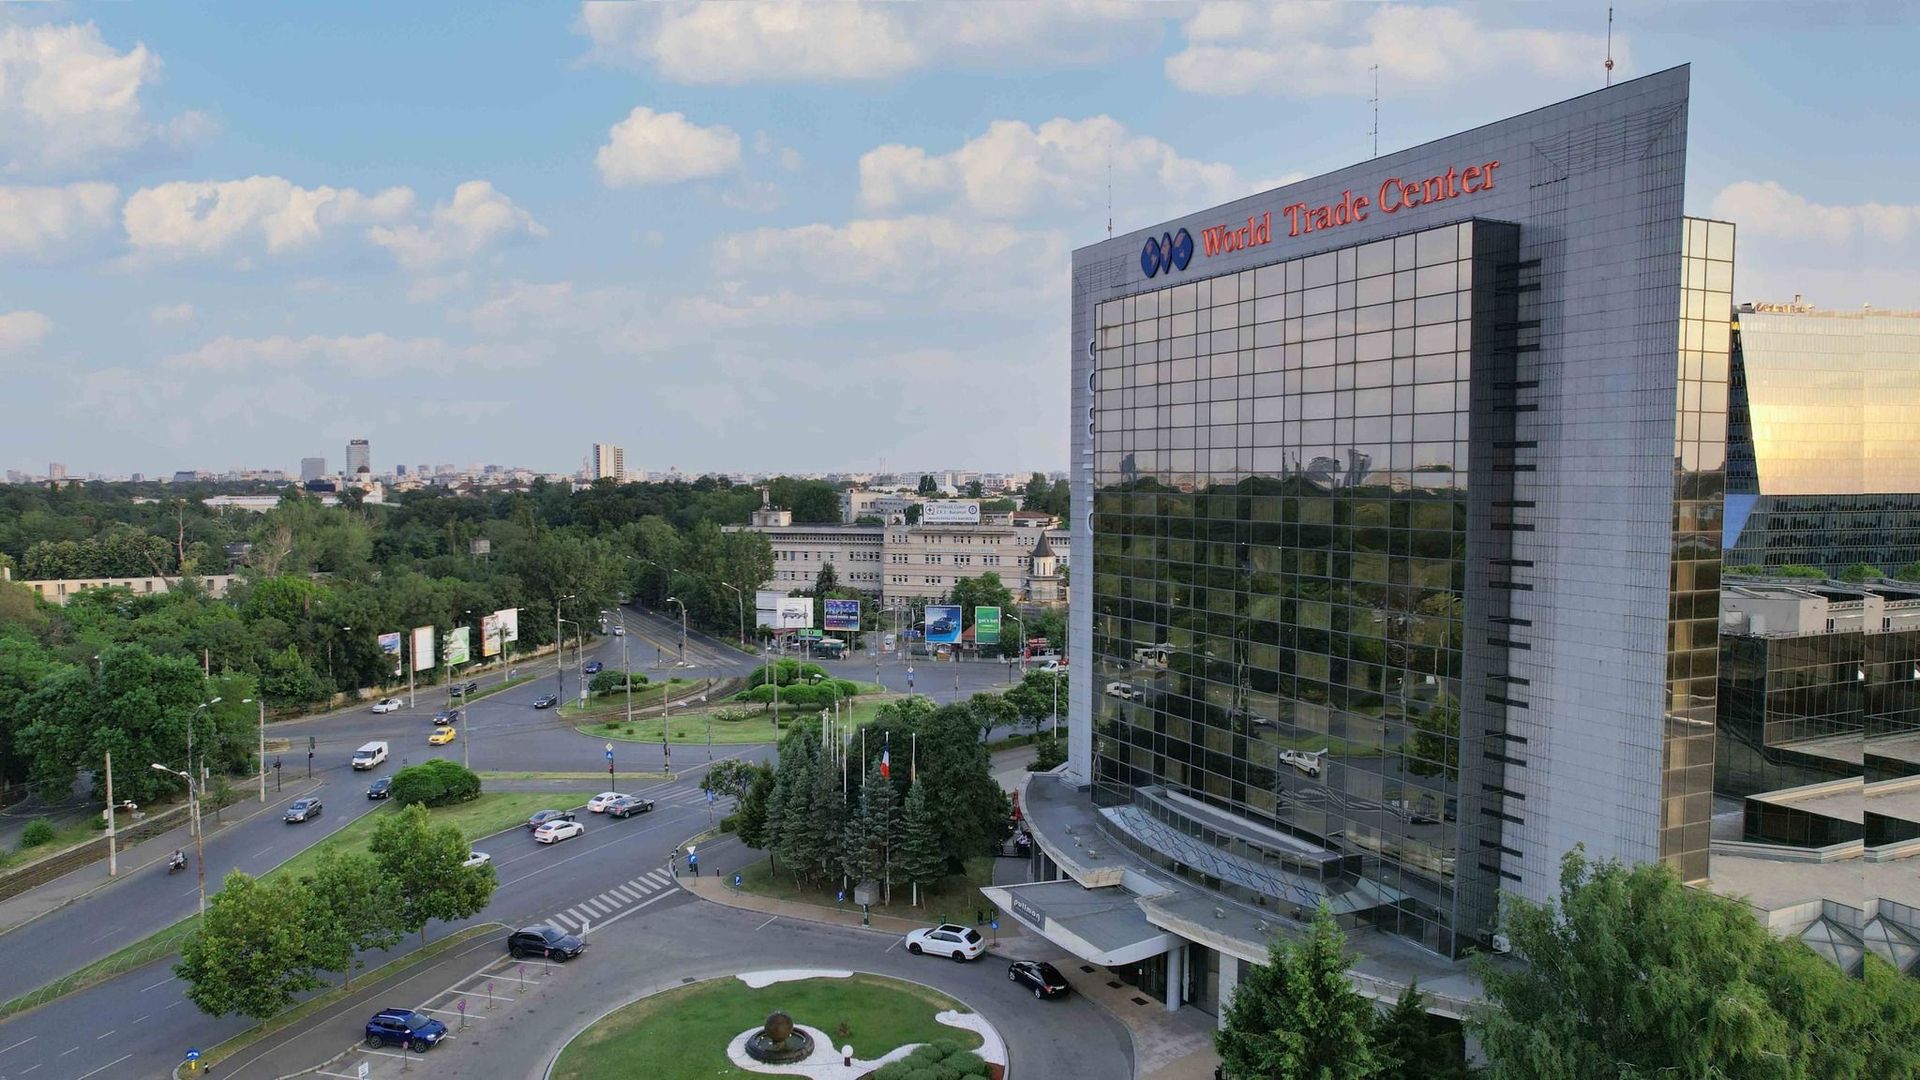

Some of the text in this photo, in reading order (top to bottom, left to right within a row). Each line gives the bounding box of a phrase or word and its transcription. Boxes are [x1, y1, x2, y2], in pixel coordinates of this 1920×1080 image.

[1201, 160, 1500, 257] World Trade Center
[1013, 899, 1041, 923] pullman
